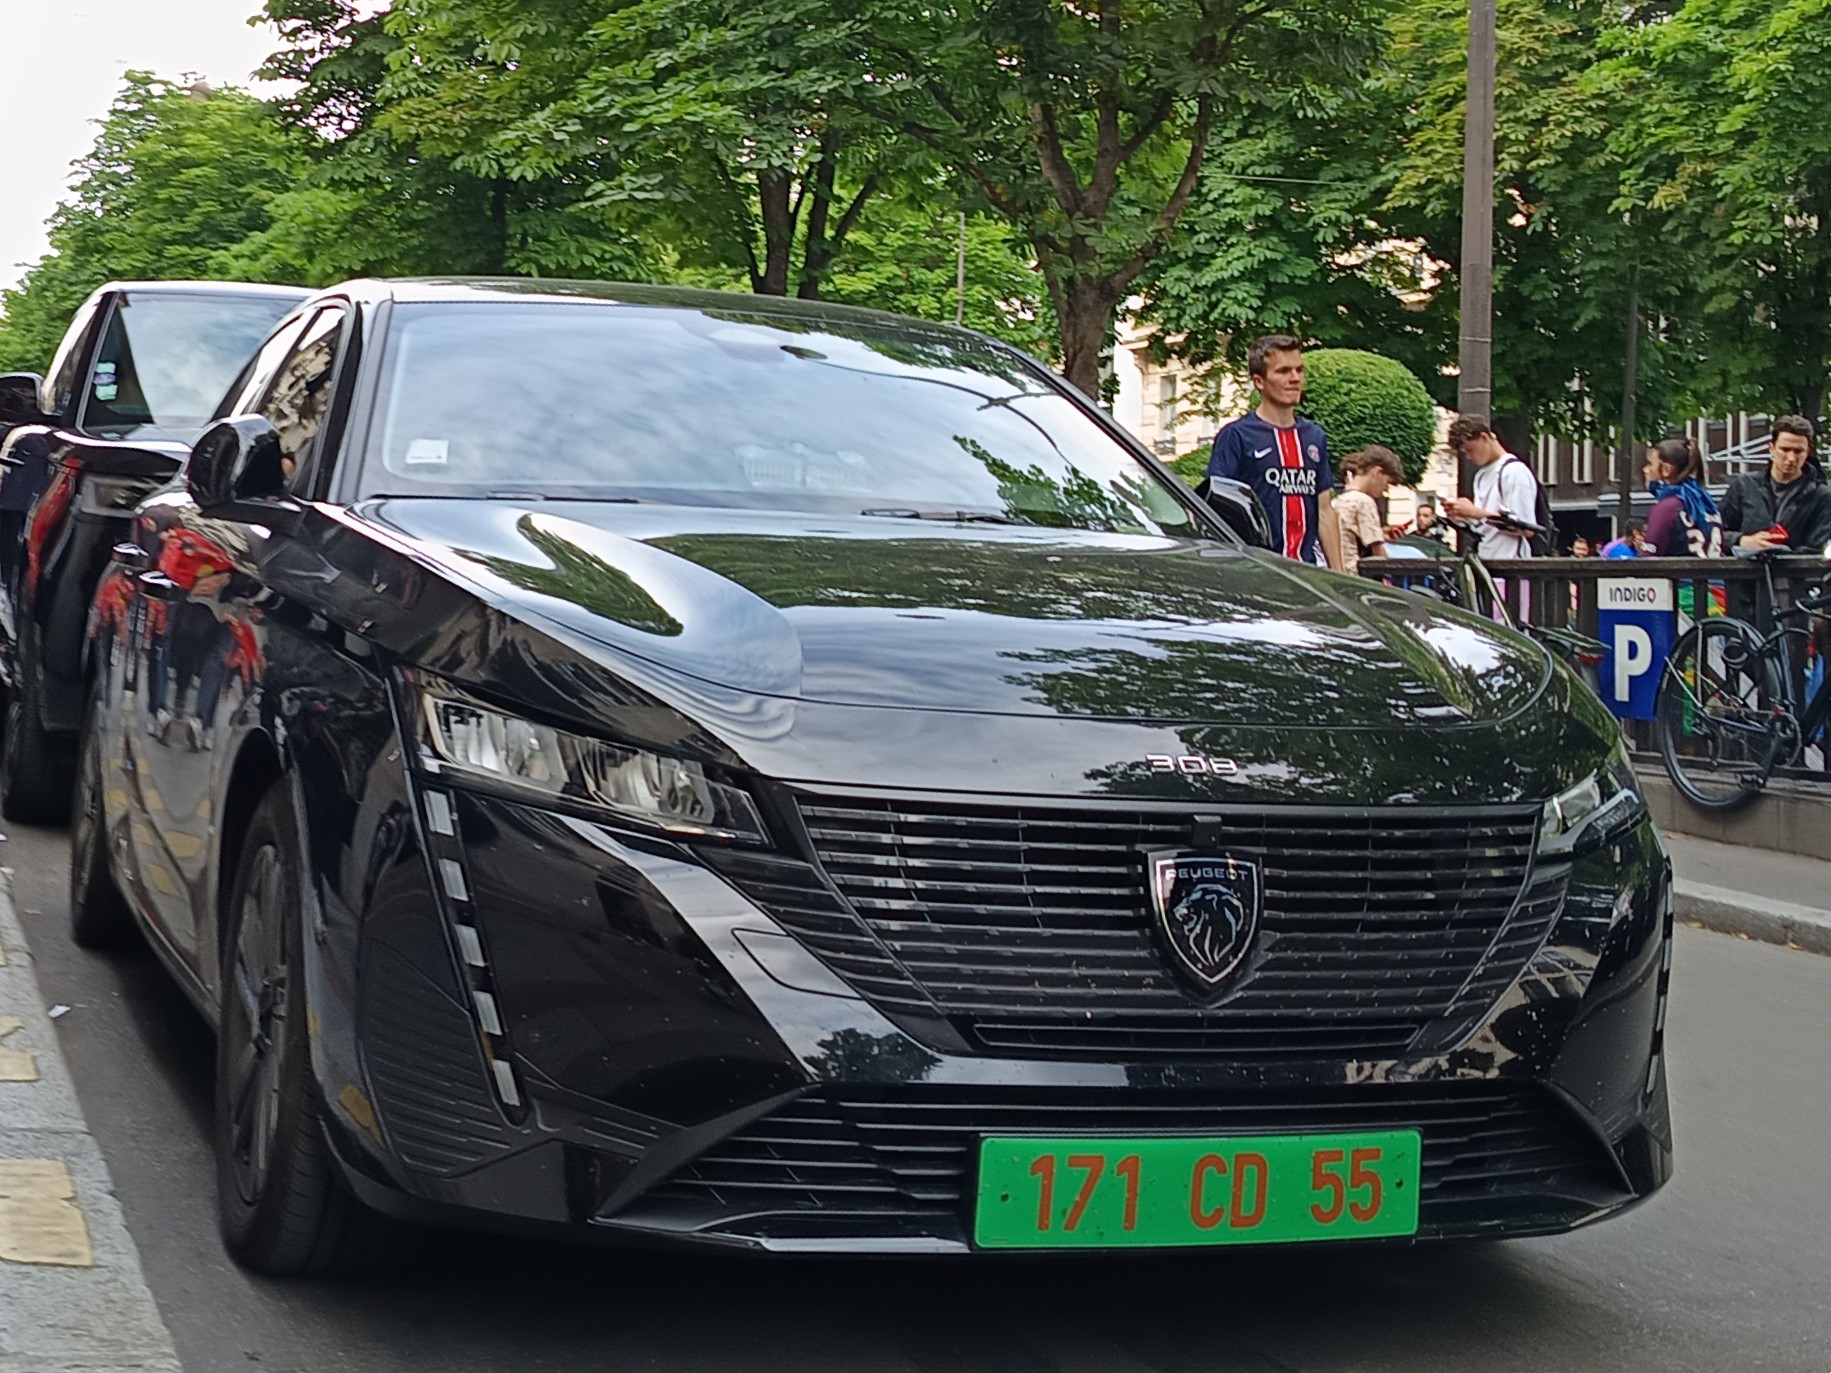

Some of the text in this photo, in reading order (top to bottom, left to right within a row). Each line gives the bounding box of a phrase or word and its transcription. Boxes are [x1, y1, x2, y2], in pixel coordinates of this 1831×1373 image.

[1265, 467, 1317, 487] QATAR
[1609, 587, 1656, 603] INDIGO
[1614, 624, 1652, 702] P
[1146, 753, 1238, 775] 308
[1164, 867, 1249, 880] PEUGEOT
[1030, 1148, 1383, 1231] 171 CD 55
